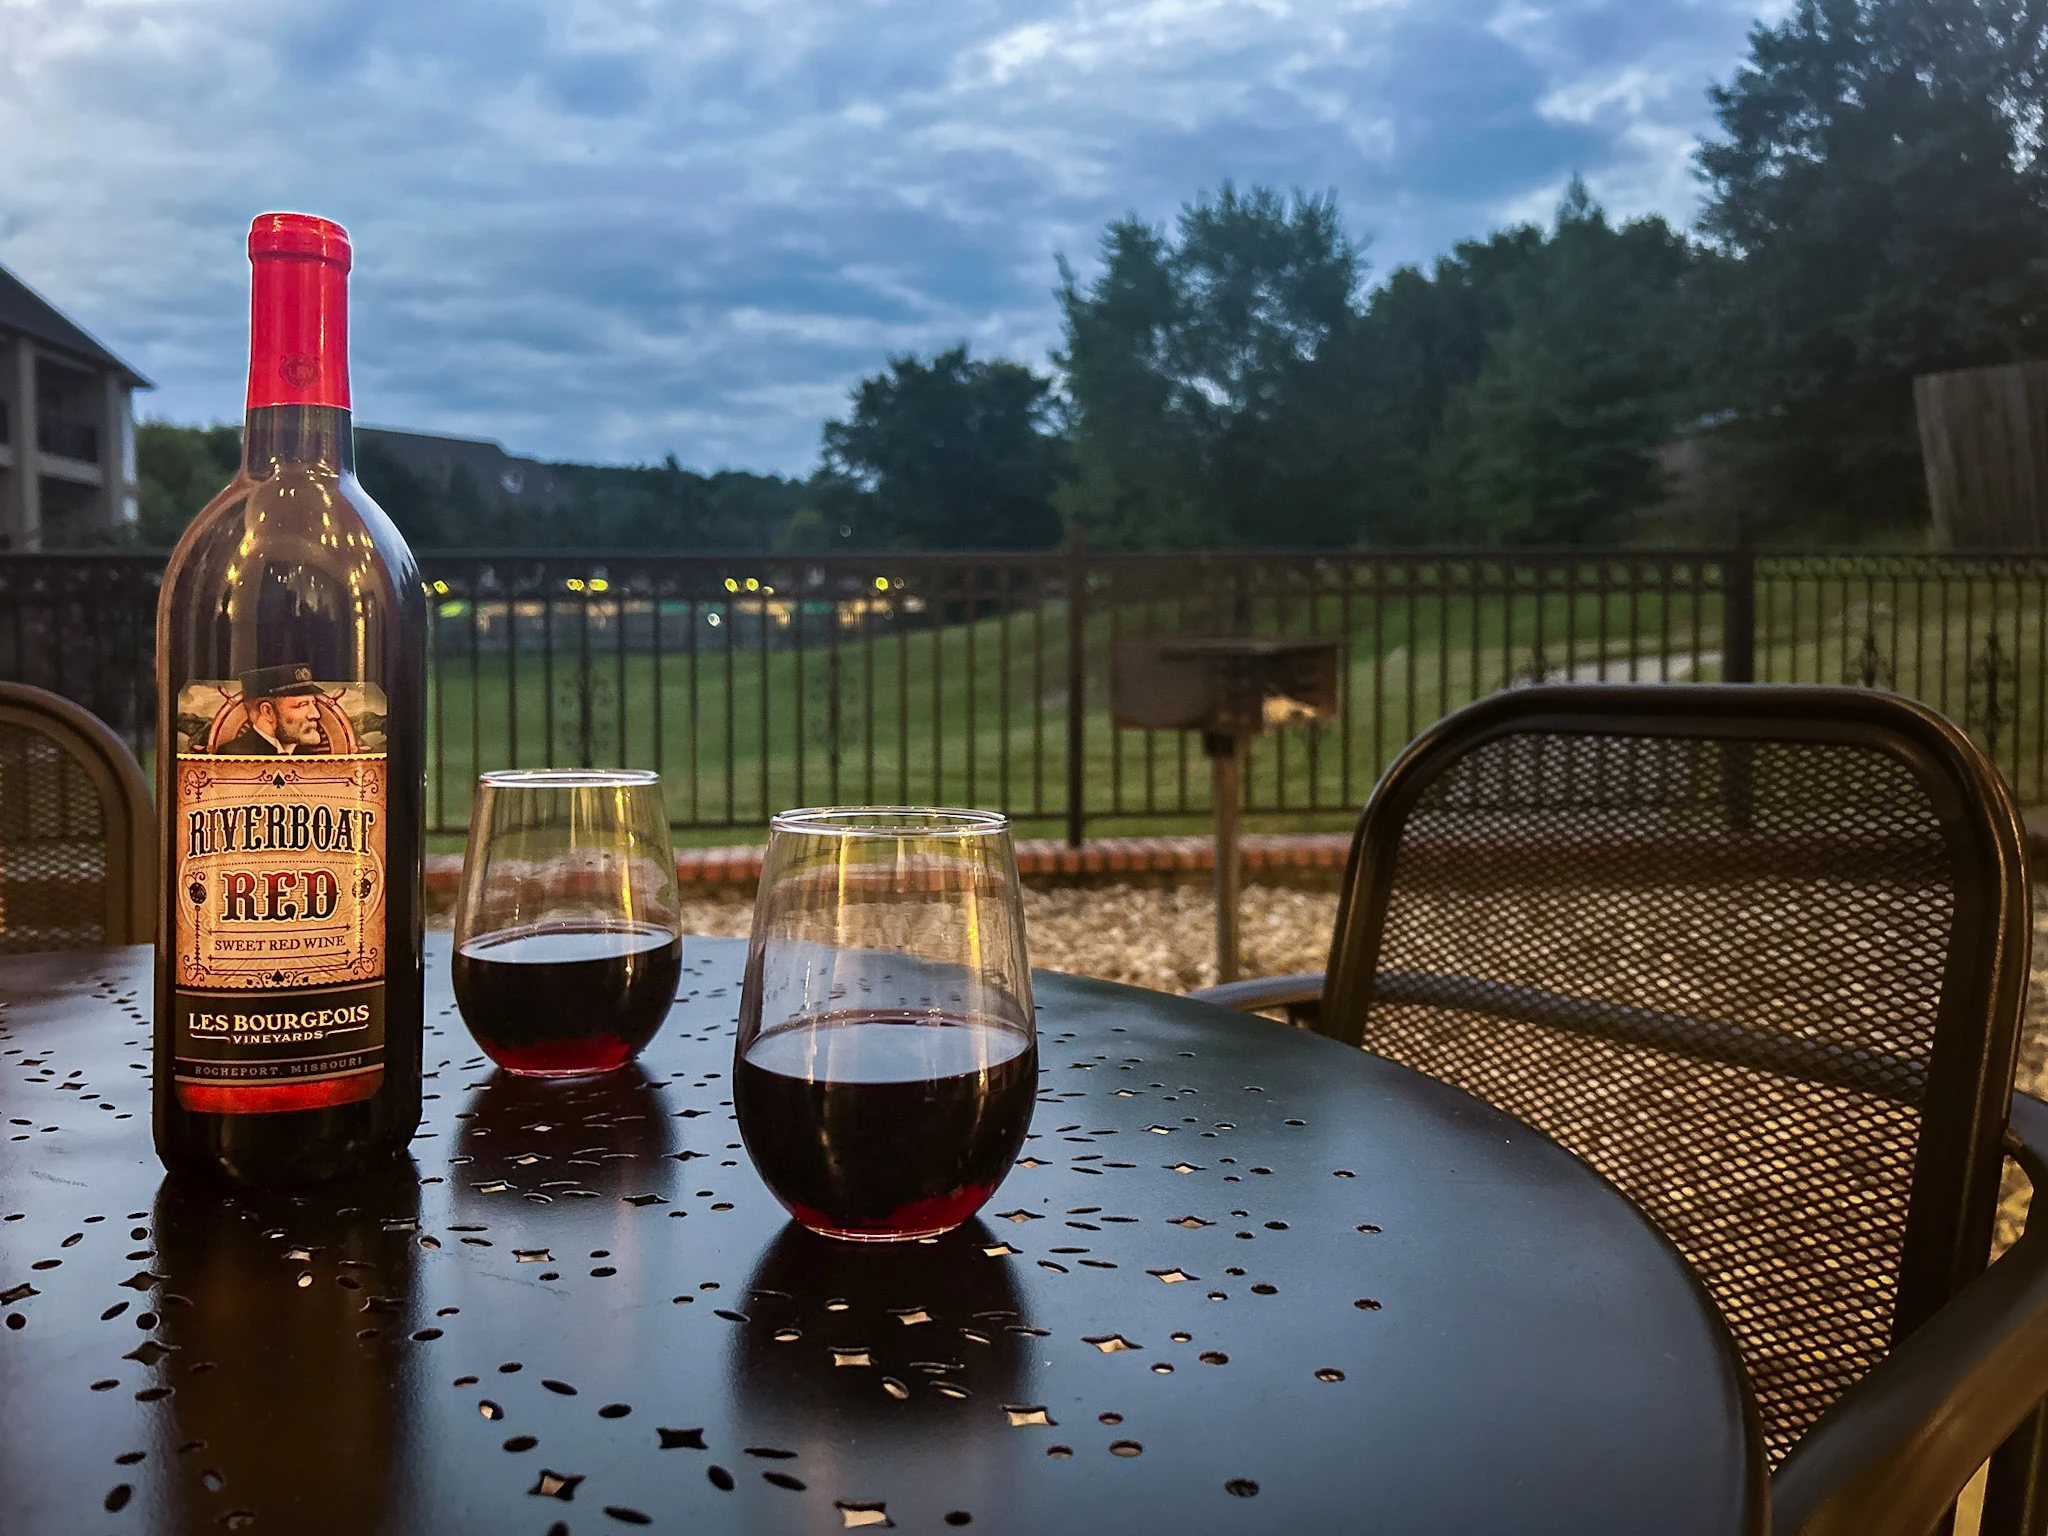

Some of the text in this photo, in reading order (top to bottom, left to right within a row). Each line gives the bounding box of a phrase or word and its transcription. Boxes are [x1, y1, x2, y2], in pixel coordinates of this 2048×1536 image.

[189, 805, 374, 857] RIVERBOAT
[221, 871, 340, 922] RED
[214, 936, 346, 951] SWEET RED WINE
[188, 1004, 370, 1032] LES BOURGEOIS
[232, 1030, 324, 1045] VINEYARDS
[290, 1057, 363, 1075] MISSOURI
